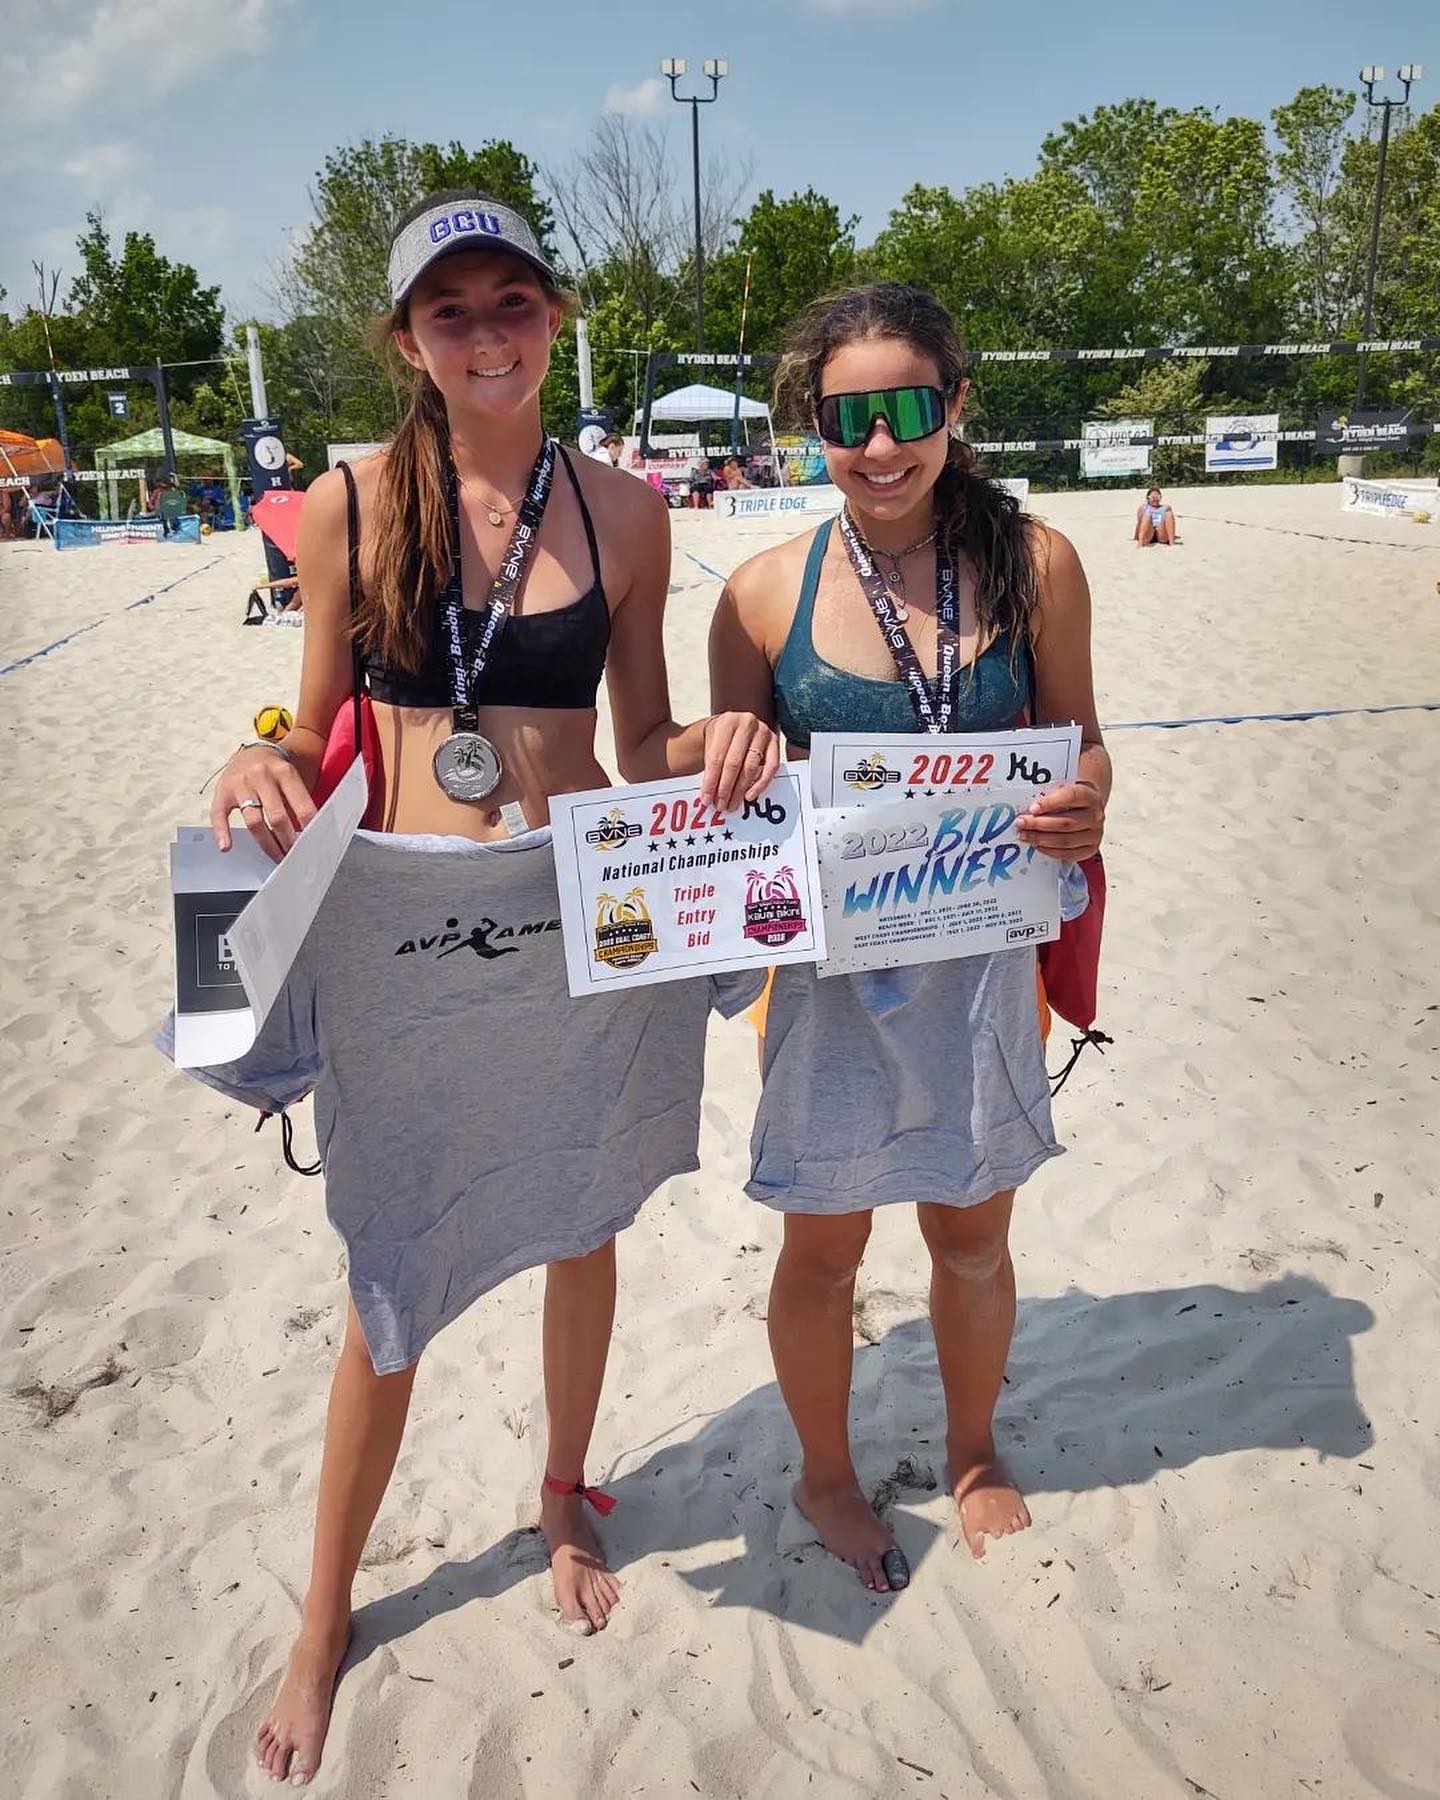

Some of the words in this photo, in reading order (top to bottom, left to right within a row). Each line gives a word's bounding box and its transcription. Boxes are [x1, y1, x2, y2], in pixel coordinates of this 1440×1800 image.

[429, 209, 501, 245] GCU
[1112, 349, 1145, 358] BEACH
[1207, 346, 1240, 356] BEACH
[1300, 344, 1331, 353] BEACH
[1391, 341, 1421, 350] BEACH
[716, 354, 751, 365] BEAH
[1017, 351, 1050, 360] BEACH
[90, 368, 130, 381] BEACH
[115, 402, 125, 414] 2
[1004, 441, 1036, 451] BEACH
[107, 469, 146, 480] BEACH
[532, 458, 552, 501] Beach
[739, 498, 775, 513] TRIPLE
[779, 496, 808, 510] EDGE
[446, 605, 462, 656] Beach
[483, 599, 505, 649] Queen
[942, 644, 954, 692] Queen
[454, 667, 468, 704] King
[845, 771, 899, 782] BVNE
[907, 753, 995, 785] 2022
[587, 825, 641, 843] BVNE
[841, 822, 929, 861] 2022
[932, 802, 1017, 856] BID
[602, 857, 664, 882] National
[669, 843, 779, 871] Championships
[674, 883, 715, 903] Triple
[677, 908, 716, 925] Entry
[394, 932, 461, 956] AVP
[687, 931, 711, 947] Bid
[598, 942, 654, 958] CHAMPIONSHIPS
[218, 963, 230, 971] TO
